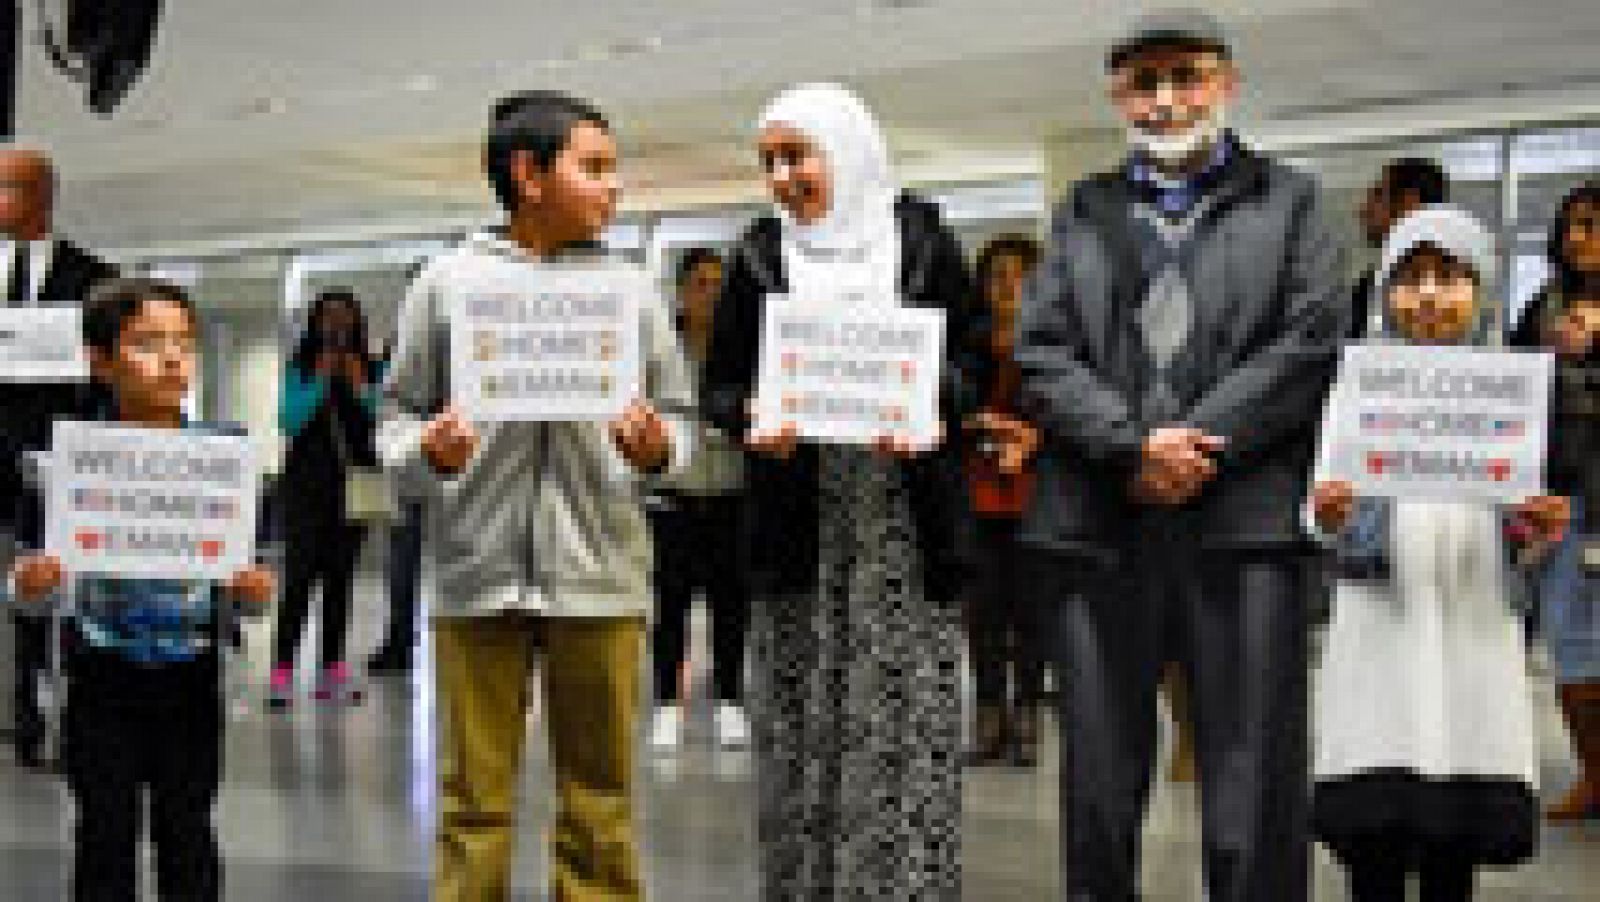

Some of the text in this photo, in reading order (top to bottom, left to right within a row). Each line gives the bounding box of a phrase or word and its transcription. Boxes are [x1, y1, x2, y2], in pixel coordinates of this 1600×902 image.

[465, 292, 624, 323] WELCOME
[1359, 366, 1530, 405] WELCOME
[70, 448, 242, 488] WELCOME
